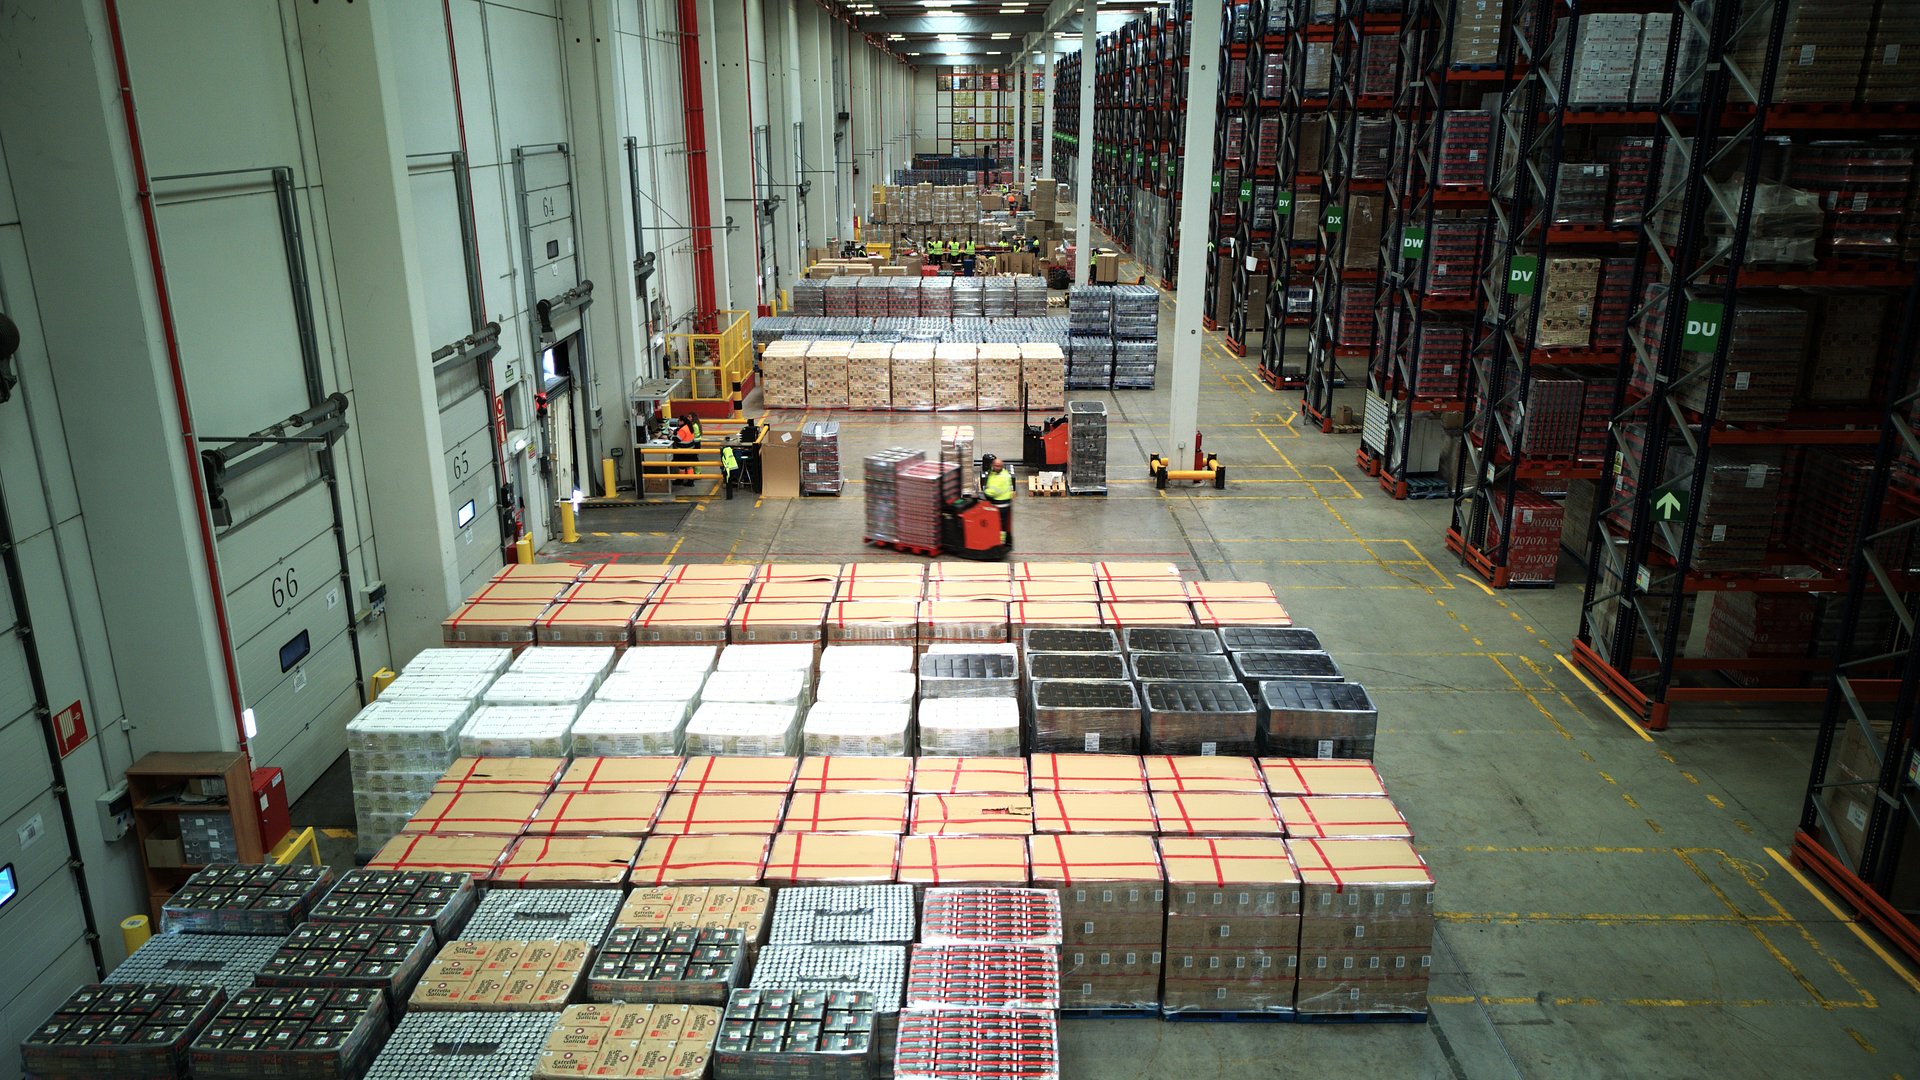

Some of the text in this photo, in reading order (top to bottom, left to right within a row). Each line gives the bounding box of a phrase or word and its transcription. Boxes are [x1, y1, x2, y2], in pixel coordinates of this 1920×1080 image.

[542, 196, 554, 217] 64
[1328, 216, 1341, 224] DX
[1404, 238, 1423, 248] DW
[1511, 270, 1533, 282] DV
[1686, 320, 1717, 336] DU
[453, 449, 468, 479] 65
[272, 568, 298, 608] 66
